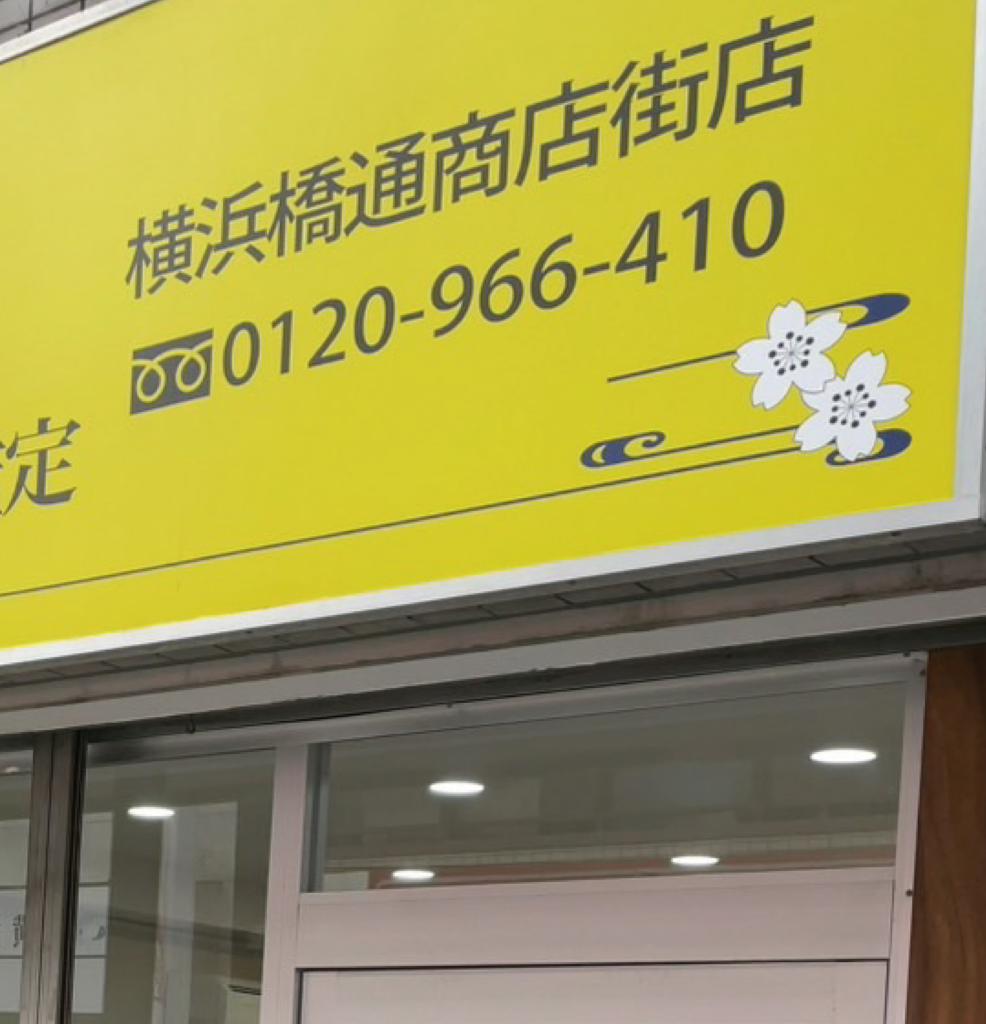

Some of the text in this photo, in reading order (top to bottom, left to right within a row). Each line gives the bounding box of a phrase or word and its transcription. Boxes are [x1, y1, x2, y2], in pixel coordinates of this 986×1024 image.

[125, 15, 814, 299] 横浜橋通商店街店
[222, 180, 786, 386] 0120-966-410
